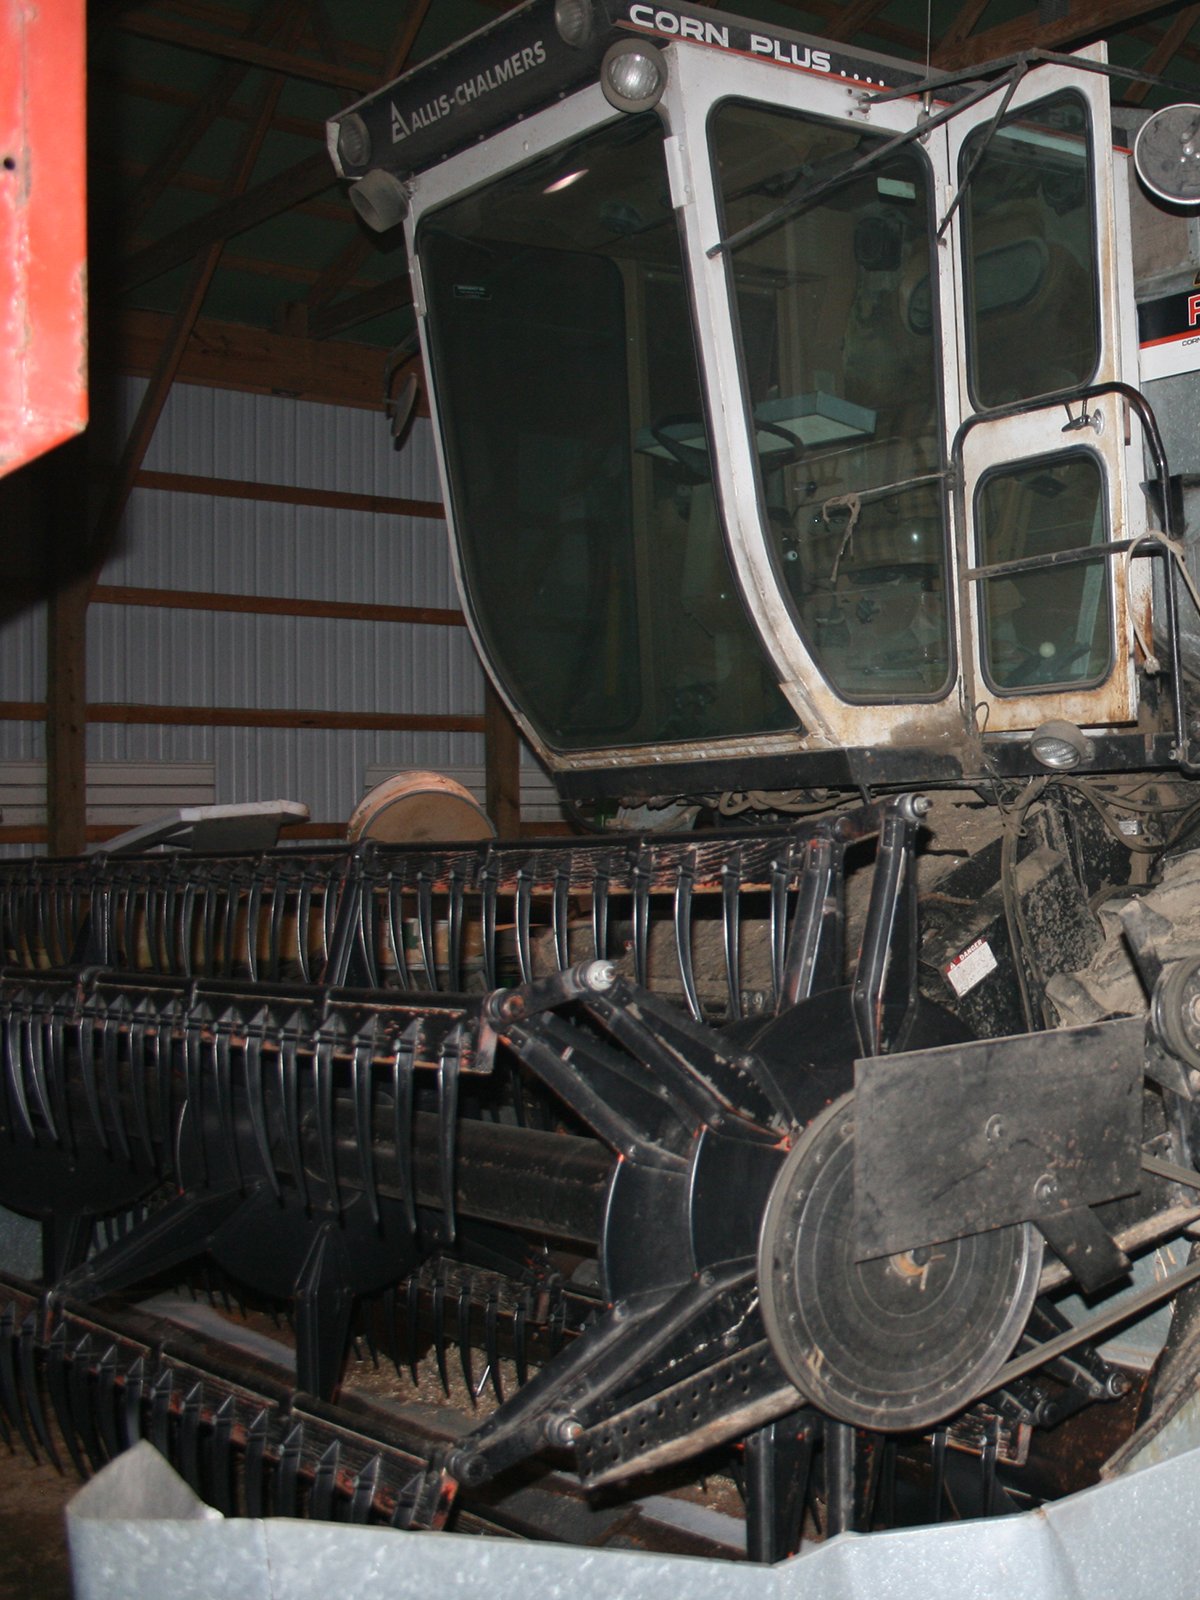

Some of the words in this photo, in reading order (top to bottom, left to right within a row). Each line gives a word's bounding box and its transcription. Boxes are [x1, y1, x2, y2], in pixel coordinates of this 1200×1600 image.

[629, 3, 730, 48] CORN
[411, 40, 547, 133] ALLIS-CHALMERS
[959, 939, 983, 961] DANGER
